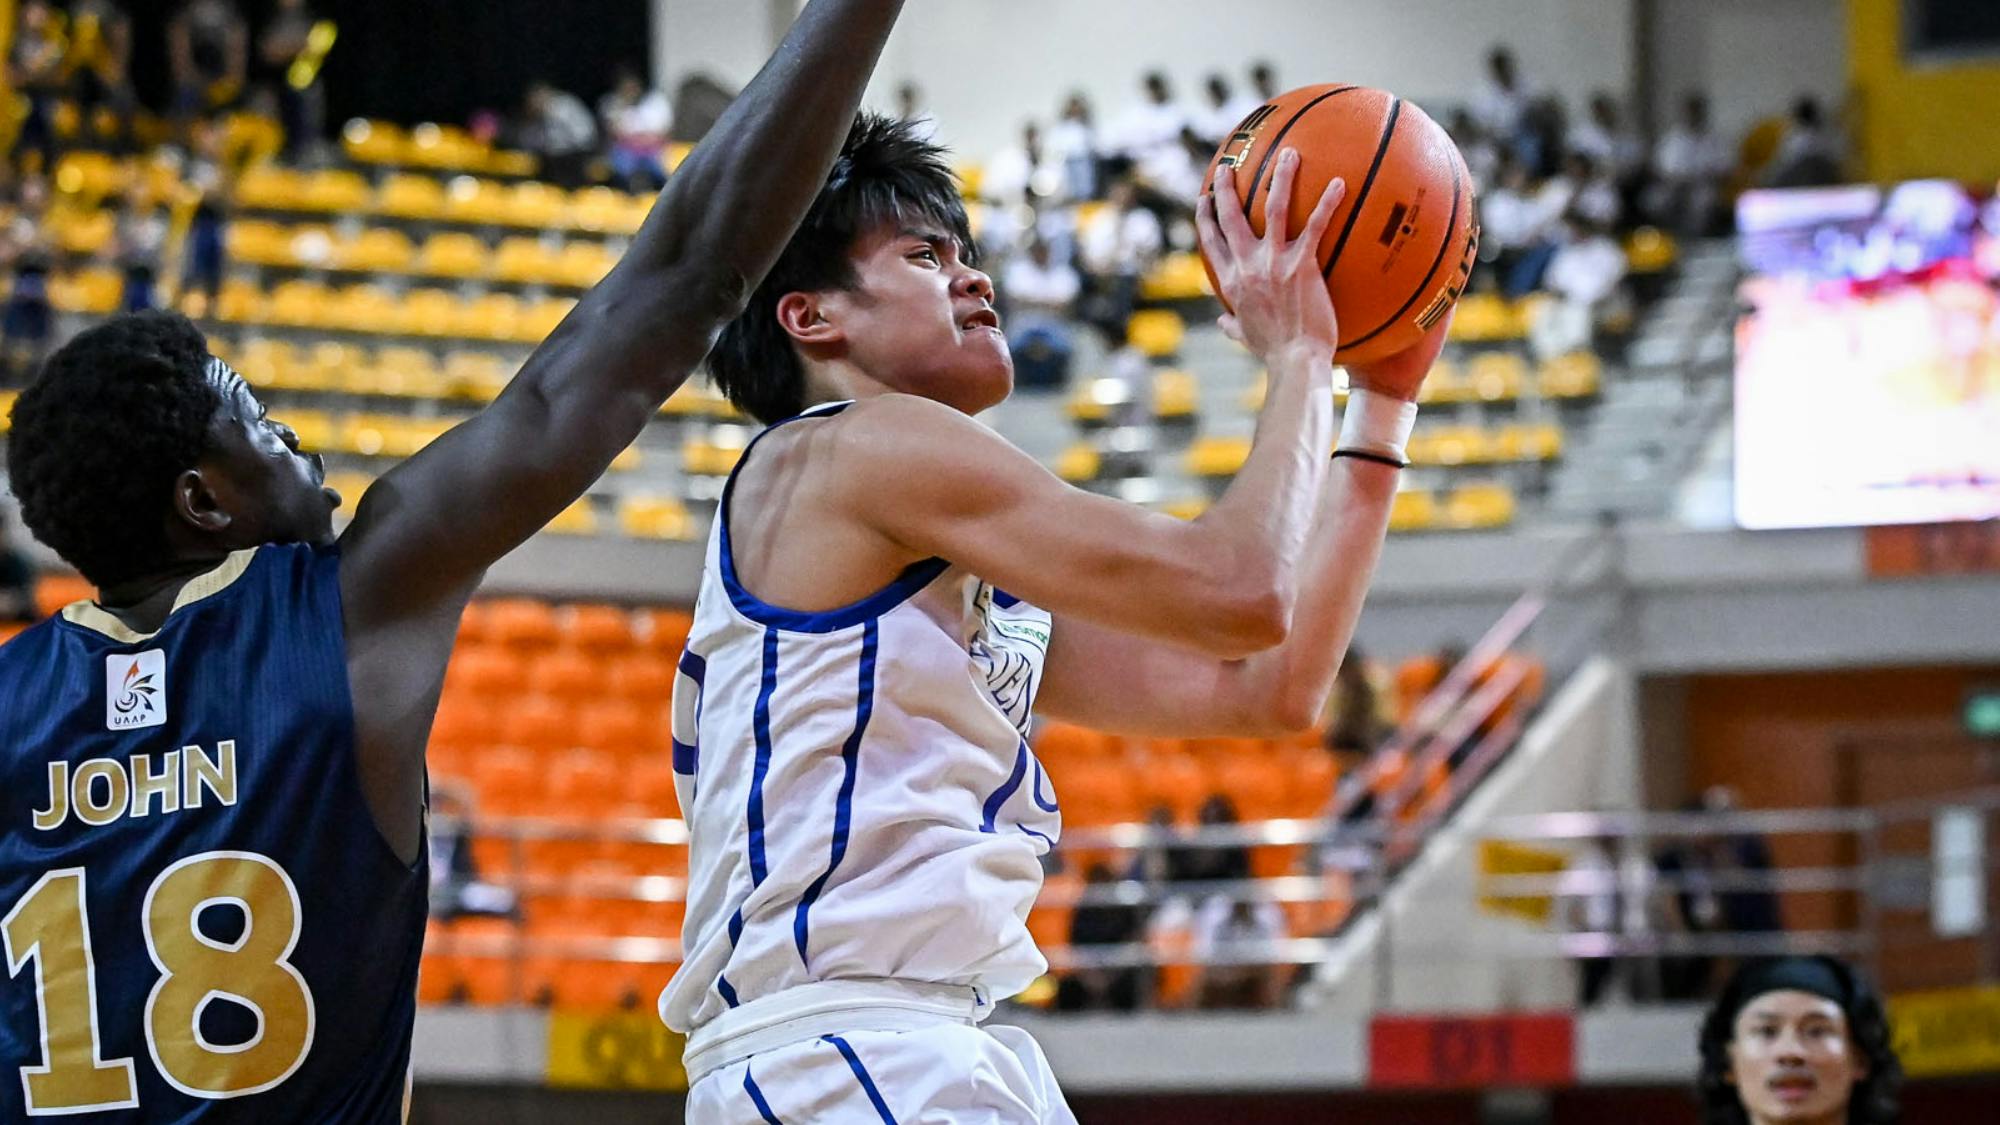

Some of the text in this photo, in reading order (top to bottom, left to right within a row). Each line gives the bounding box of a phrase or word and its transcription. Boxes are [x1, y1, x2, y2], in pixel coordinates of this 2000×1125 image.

[114, 714, 146, 725] UAAP
[32, 739, 237, 831] JOHN
[1, 850, 316, 1116] 18
